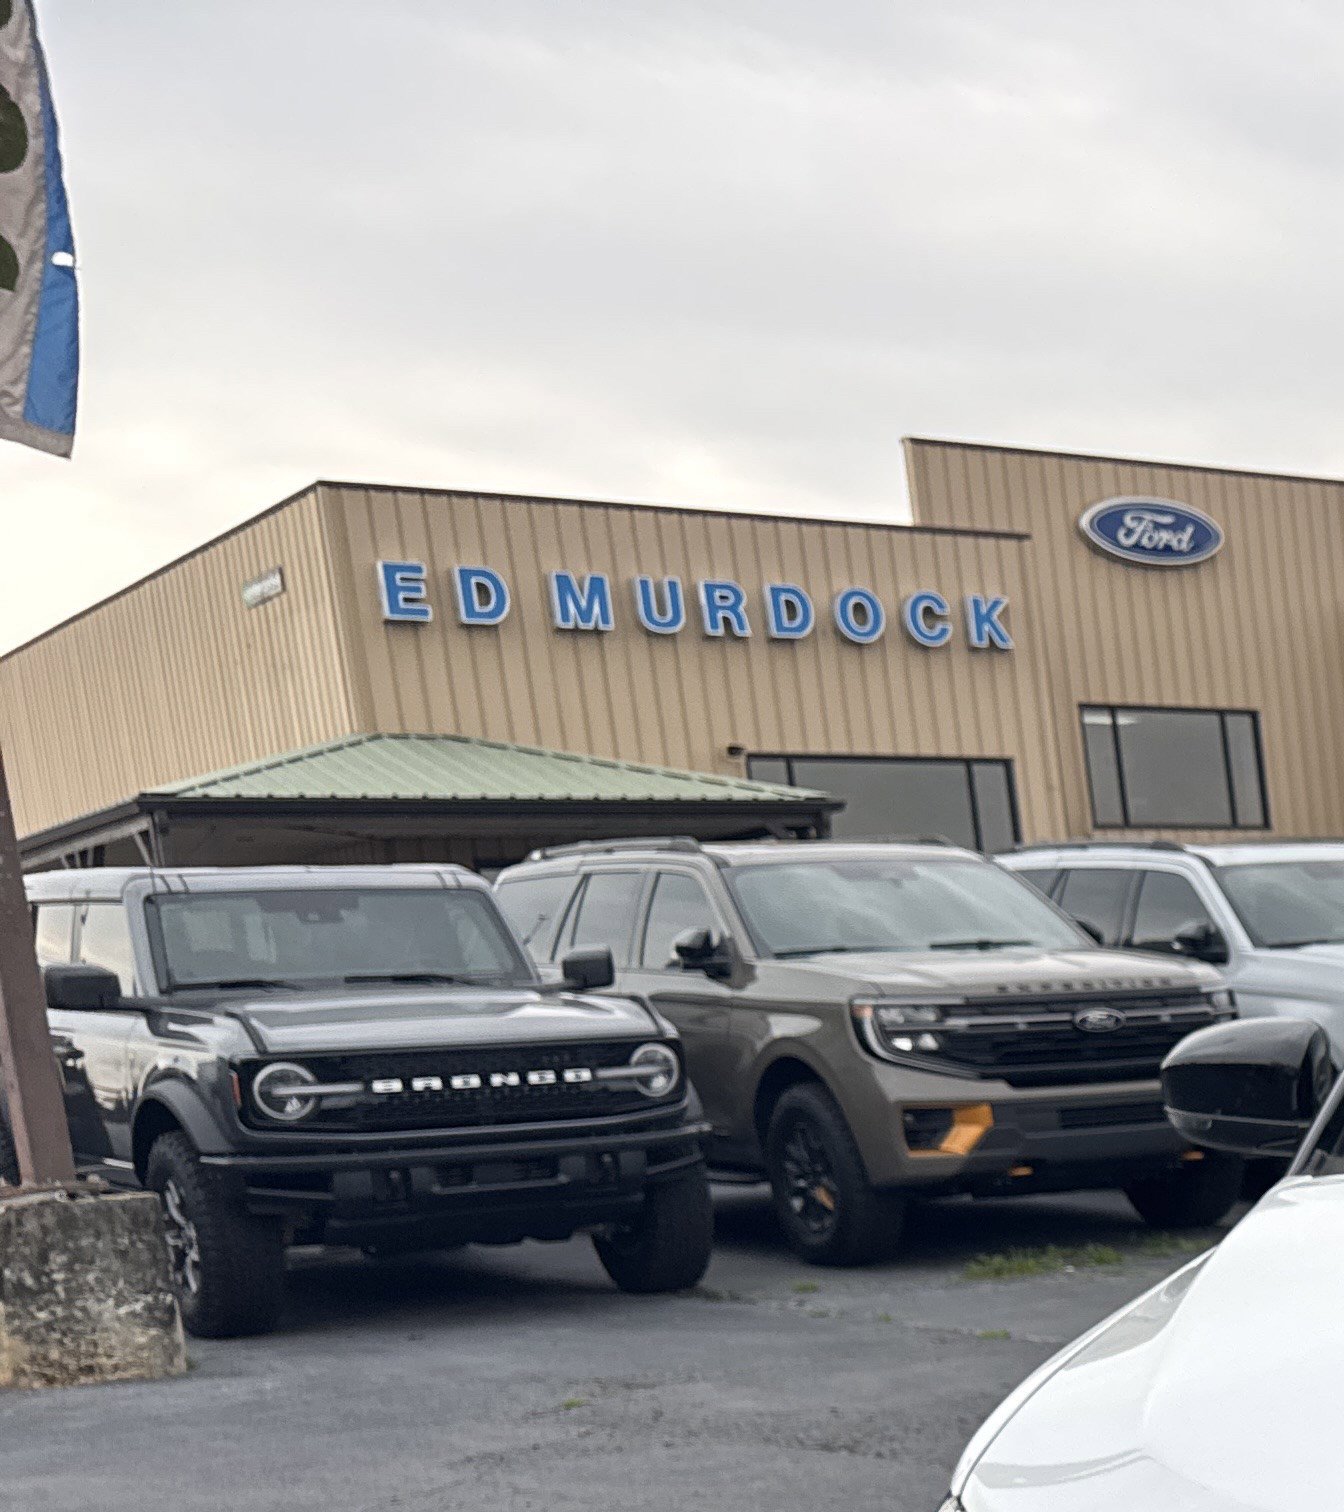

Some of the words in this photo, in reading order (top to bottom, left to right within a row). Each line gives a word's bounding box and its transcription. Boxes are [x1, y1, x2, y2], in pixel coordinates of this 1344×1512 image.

[1117, 509, 1196, 553] Ford
[376, 559, 512, 626] ED
[550, 569, 1015, 651] MURDOCK
